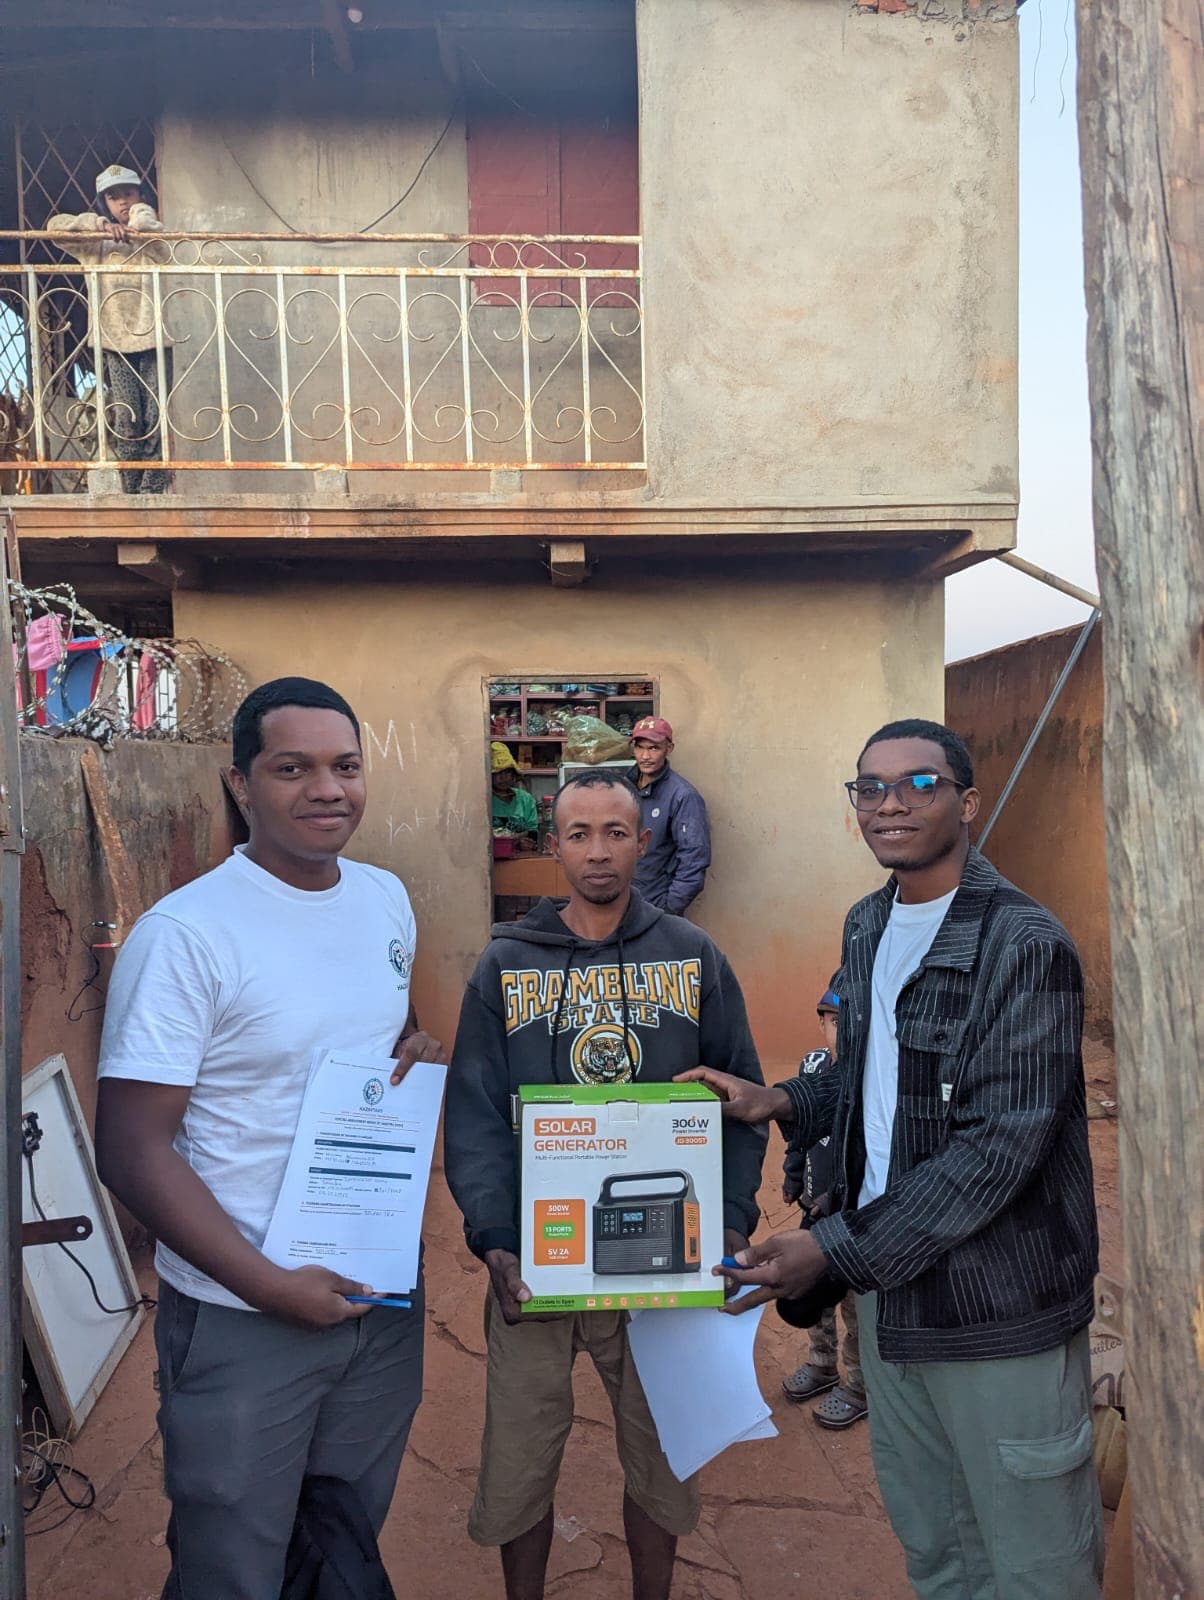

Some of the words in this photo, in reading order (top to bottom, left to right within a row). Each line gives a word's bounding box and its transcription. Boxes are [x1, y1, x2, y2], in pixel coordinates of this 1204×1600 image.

[500, 958, 701, 1036] GRAMBLING
[548, 1002, 660, 1035] STATE
[539, 1120, 592, 1133] SOLAR
[534, 1138, 627, 1152] GENERATOR
